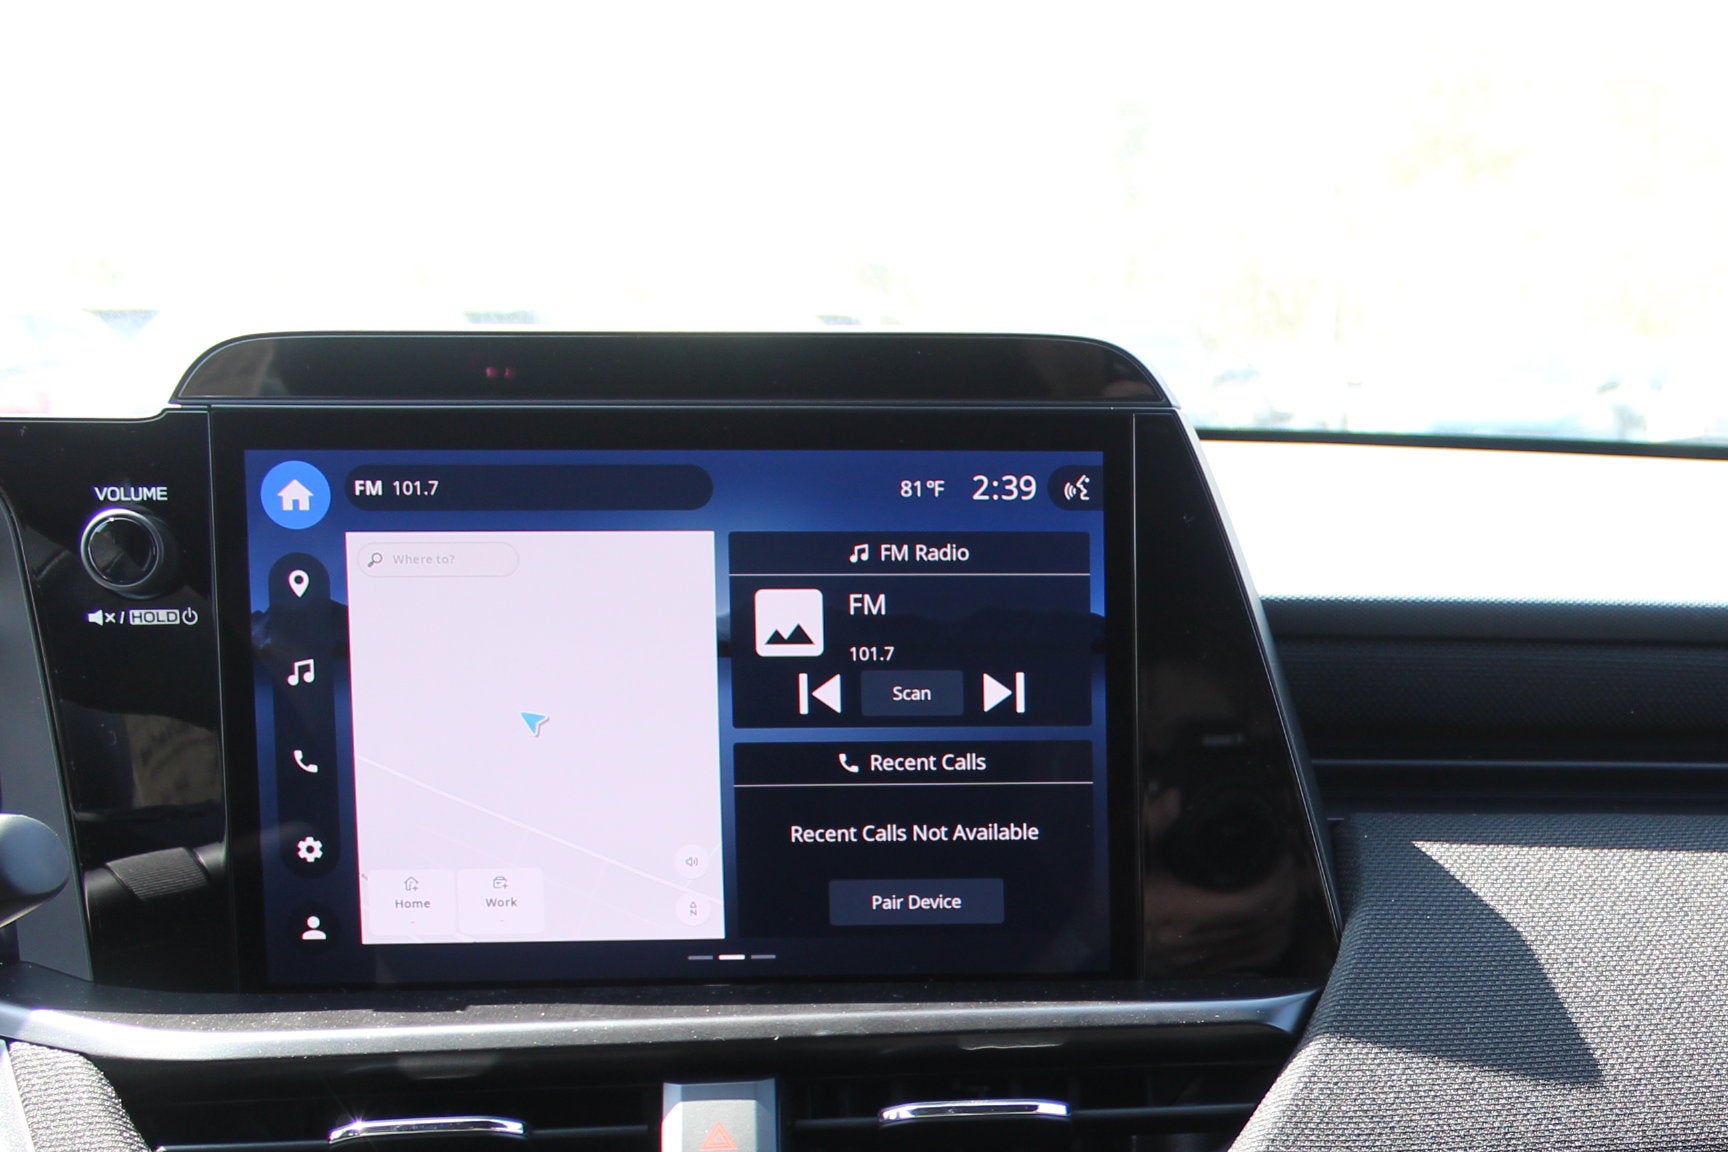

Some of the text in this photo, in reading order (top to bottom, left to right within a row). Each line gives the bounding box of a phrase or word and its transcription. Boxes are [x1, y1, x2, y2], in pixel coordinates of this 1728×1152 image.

[94, 486, 168, 501] VOLUME
[354, 480, 439, 496] FM 101.7
[972, 475, 1037, 500] 2:39
[393, 555, 455, 564] Where to?
[880, 544, 969, 562] FM Radio
[849, 594, 886, 615] FM
[131, 611, 178, 623] HOLD
[849, 647, 894, 661] 101.7
[892, 686, 931, 701] Scan
[870, 754, 986, 771] Recent Calls
[791, 823, 1039, 842] Recent Calls Not Available
[395, 898, 517, 908] Home Work
[871, 894, 962, 910] Pair Device
